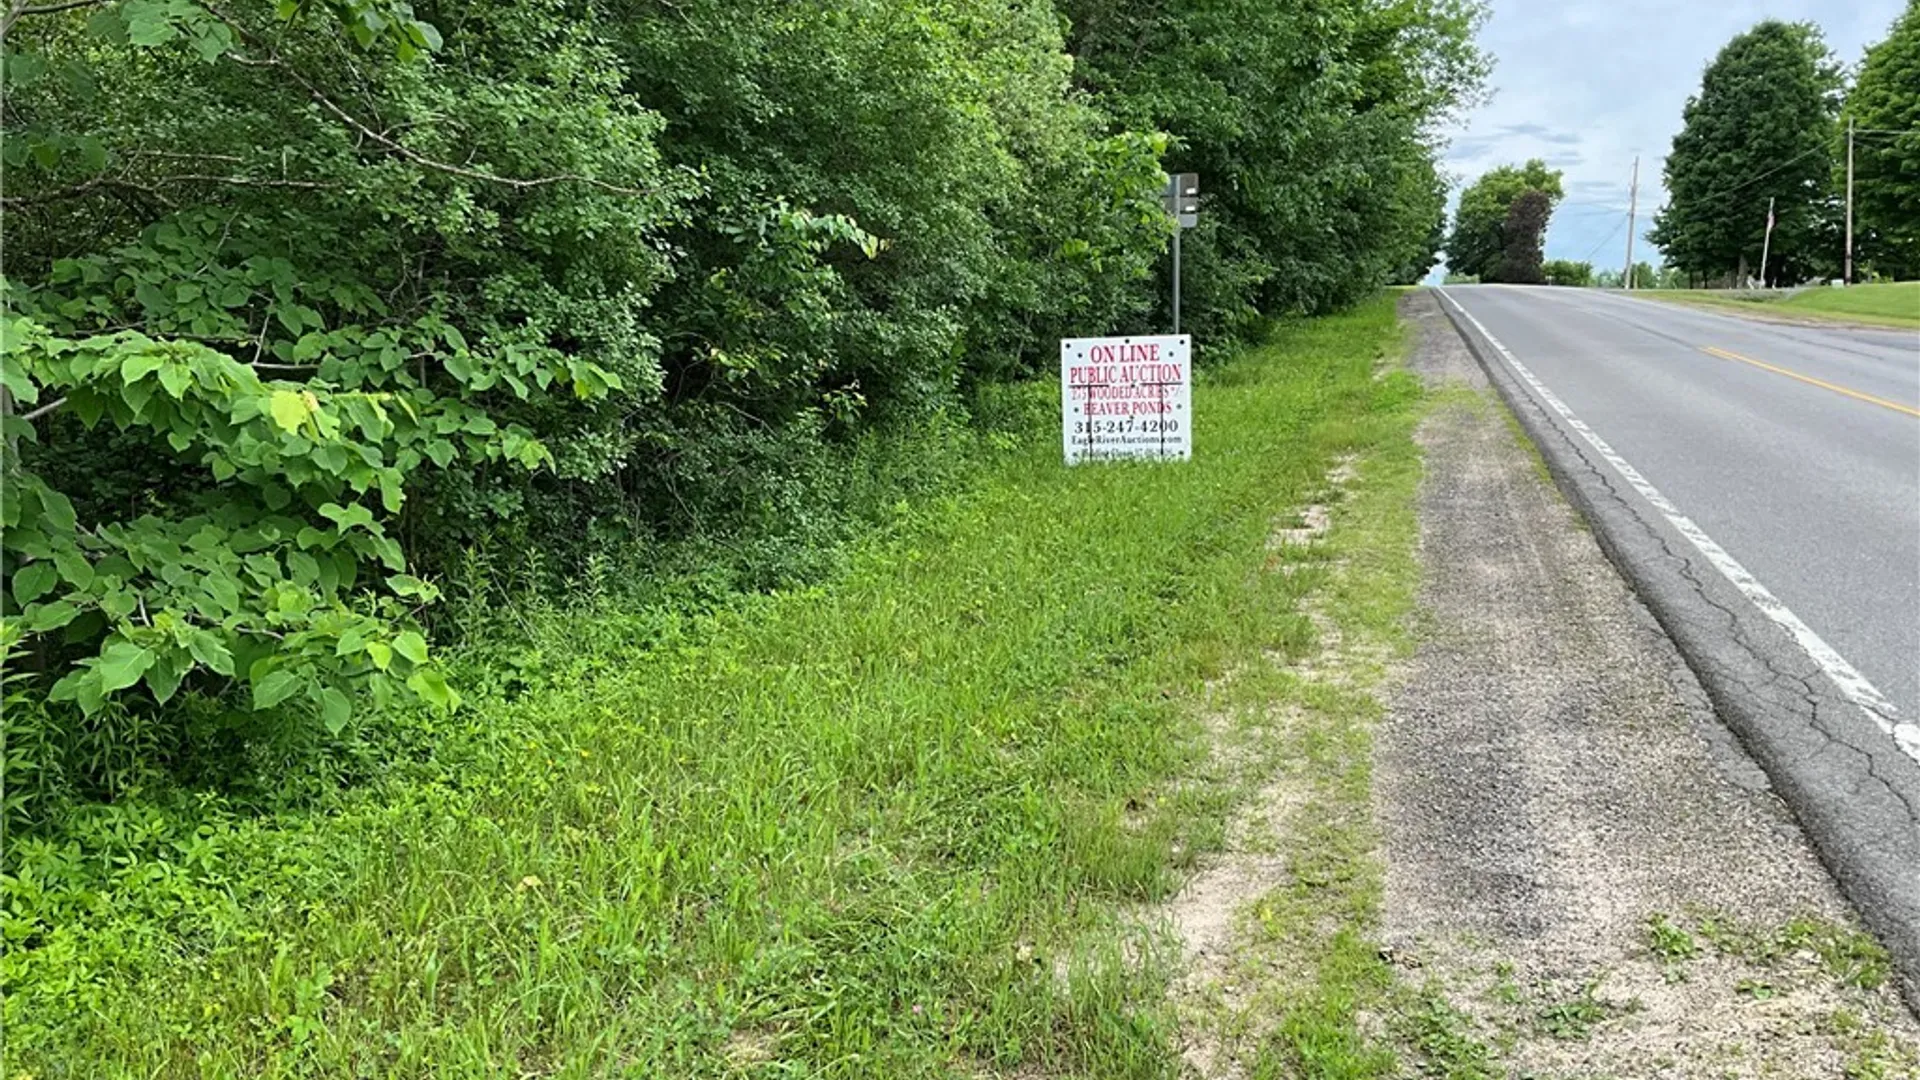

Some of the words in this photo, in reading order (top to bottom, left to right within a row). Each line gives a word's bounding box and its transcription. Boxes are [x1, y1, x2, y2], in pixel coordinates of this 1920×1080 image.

[1090, 345, 1115, 363] ON
[1119, 344, 1160, 363] LINE
[1070, 366, 1117, 384] PUBLIC
[1119, 364, 1183, 383] AUCTION
[1087, 385, 1131, 400] WOODED
[1133, 384, 1170, 400] ACRES
[1084, 403, 1131, 416] BEAVER
[1132, 401, 1173, 415] PONDS
[1074, 419, 1179, 434] 315-247-4200
